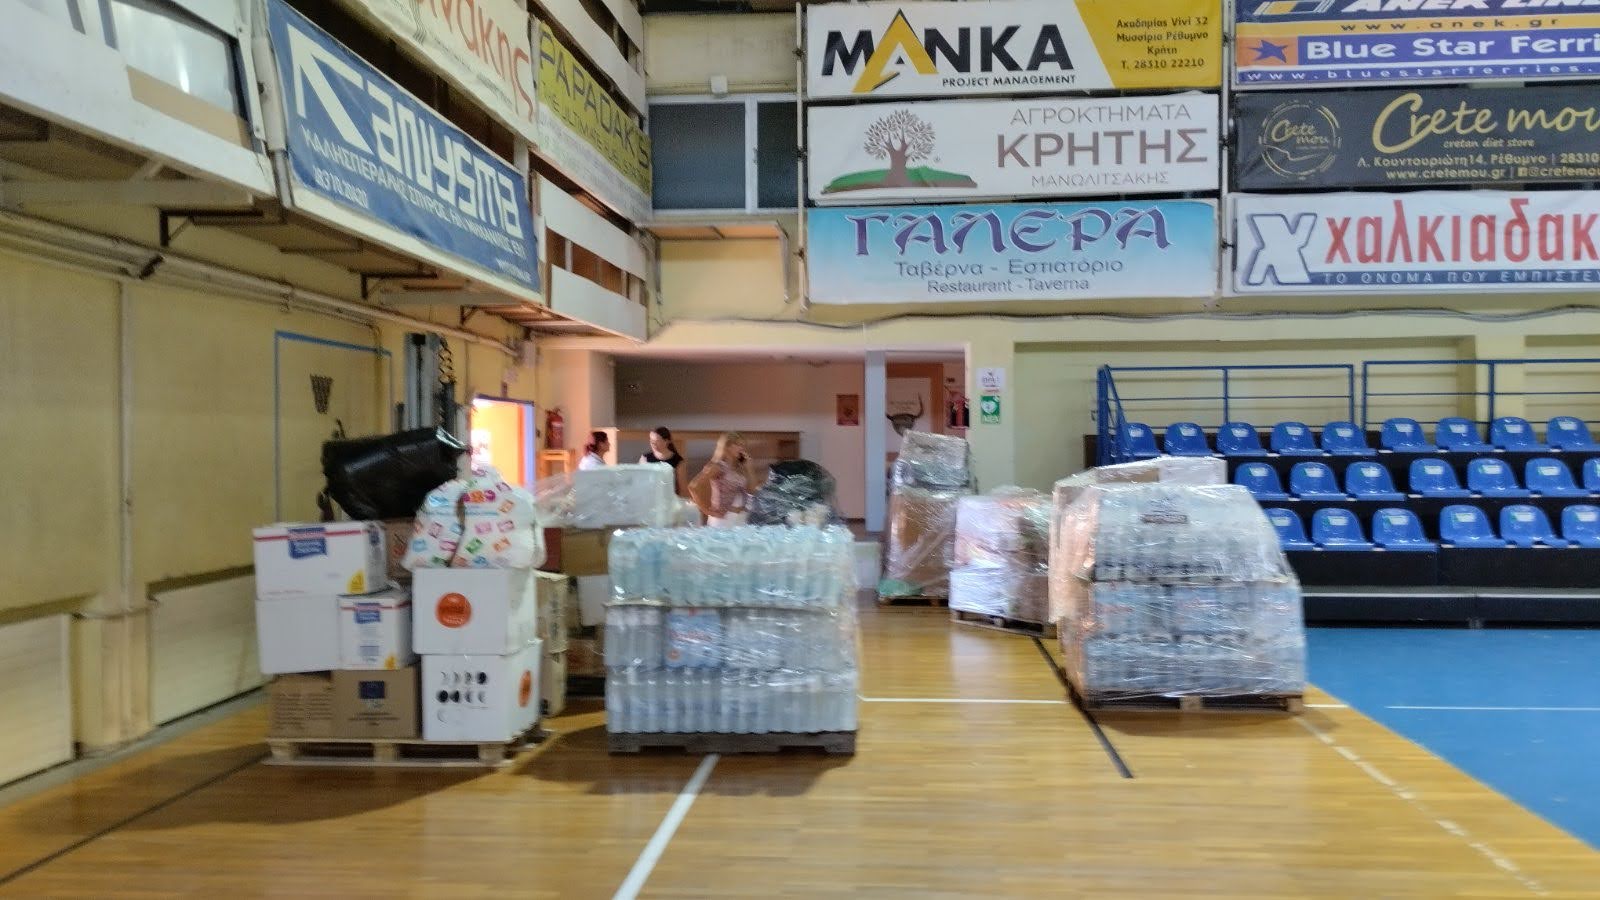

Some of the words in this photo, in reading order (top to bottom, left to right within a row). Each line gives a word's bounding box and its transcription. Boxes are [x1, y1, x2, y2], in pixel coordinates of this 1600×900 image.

[1195, 16, 1208, 25] 32
[1341, 17, 1560, 32] www.anek.gr
[821, 8, 1075, 93] MANKA
[1147, 46, 1177, 57] Κρήτη
[1307, 41, 1396, 60] Blue
[1413, 37, 1496, 57] Star
[1134, 60, 1167, 69] 28310
[1170, 58, 1204, 68] 22210
[942, 77, 989, 87] PROJECT
[993, 75, 1076, 87] MANAGEMENT
[1010, 103, 1191, 125] ΑΓΡΟΚΤΗΜΑΤΑ
[1372, 92, 1498, 153] Crete
[1271, 119, 1317, 142] Crete
[997, 128, 1207, 168] ΚΡΗΤΗΣ
[1482, 138, 1503, 147] diet
[1507, 138, 1535, 147] store
[1032, 171, 1168, 188] ΜΑΝΩΛΙΤΣΑΚΗΣ
[1386, 167, 1506, 180] www.cretemou.gr
[845, 206, 1174, 256] ΓΑΛΕΡΑ
[894, 259, 984, 279] Ταβέρνα
[1008, 257, 1124, 275] Εστιατόριο
[1325, 272, 1348, 284] ΤΟ
[1361, 270, 1435, 284] ΟΝΟΜΑ
[1448, 270, 1488, 283] ΠΟΥ
[927, 277, 1013, 294] Restaurant
[1025, 275, 1090, 292] Taverna
